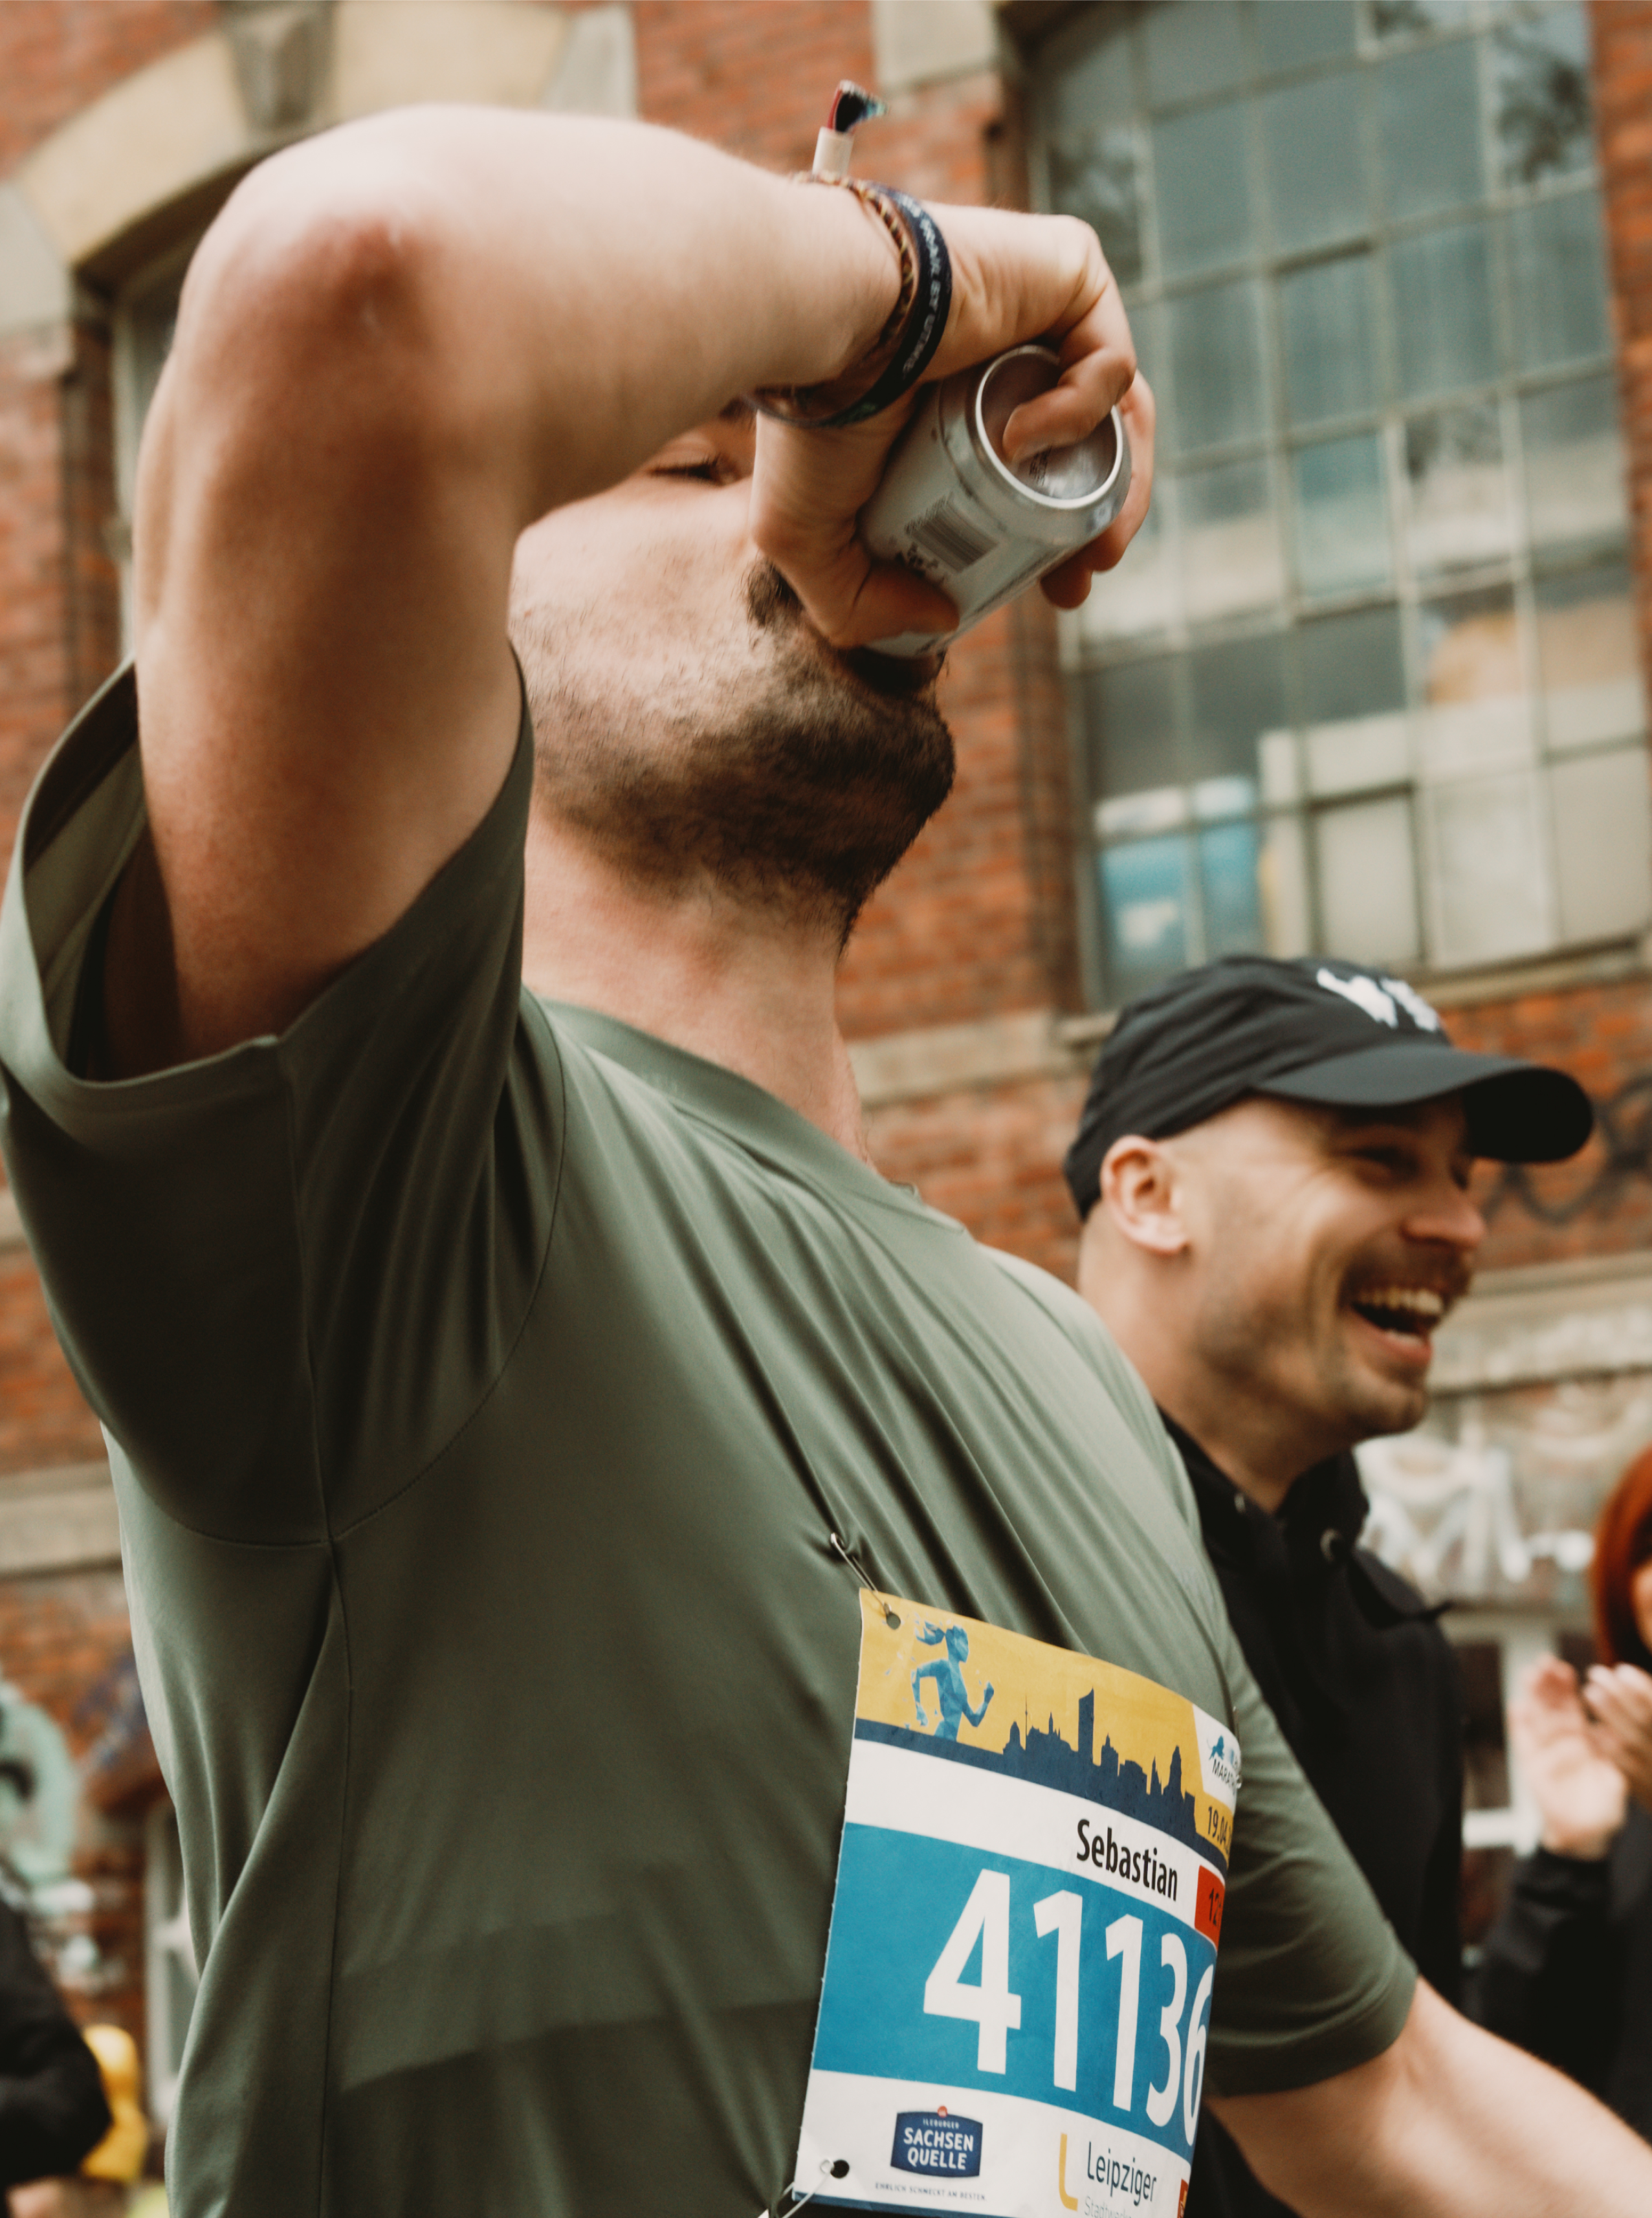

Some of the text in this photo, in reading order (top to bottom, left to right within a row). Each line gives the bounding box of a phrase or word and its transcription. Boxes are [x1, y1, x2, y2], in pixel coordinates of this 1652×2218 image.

[1076, 1818, 1178, 1902] Sebastian
[1209, 1887, 1222, 1928] 12
[923, 1869, 1214, 2146] 41136
[903, 2127, 974, 2152] SACHSEN
[907, 2147, 967, 2171] QUELLE
[875, 2182, 907, 2193] EHRLICH
[1087, 2140, 1157, 2206] Leipziger
